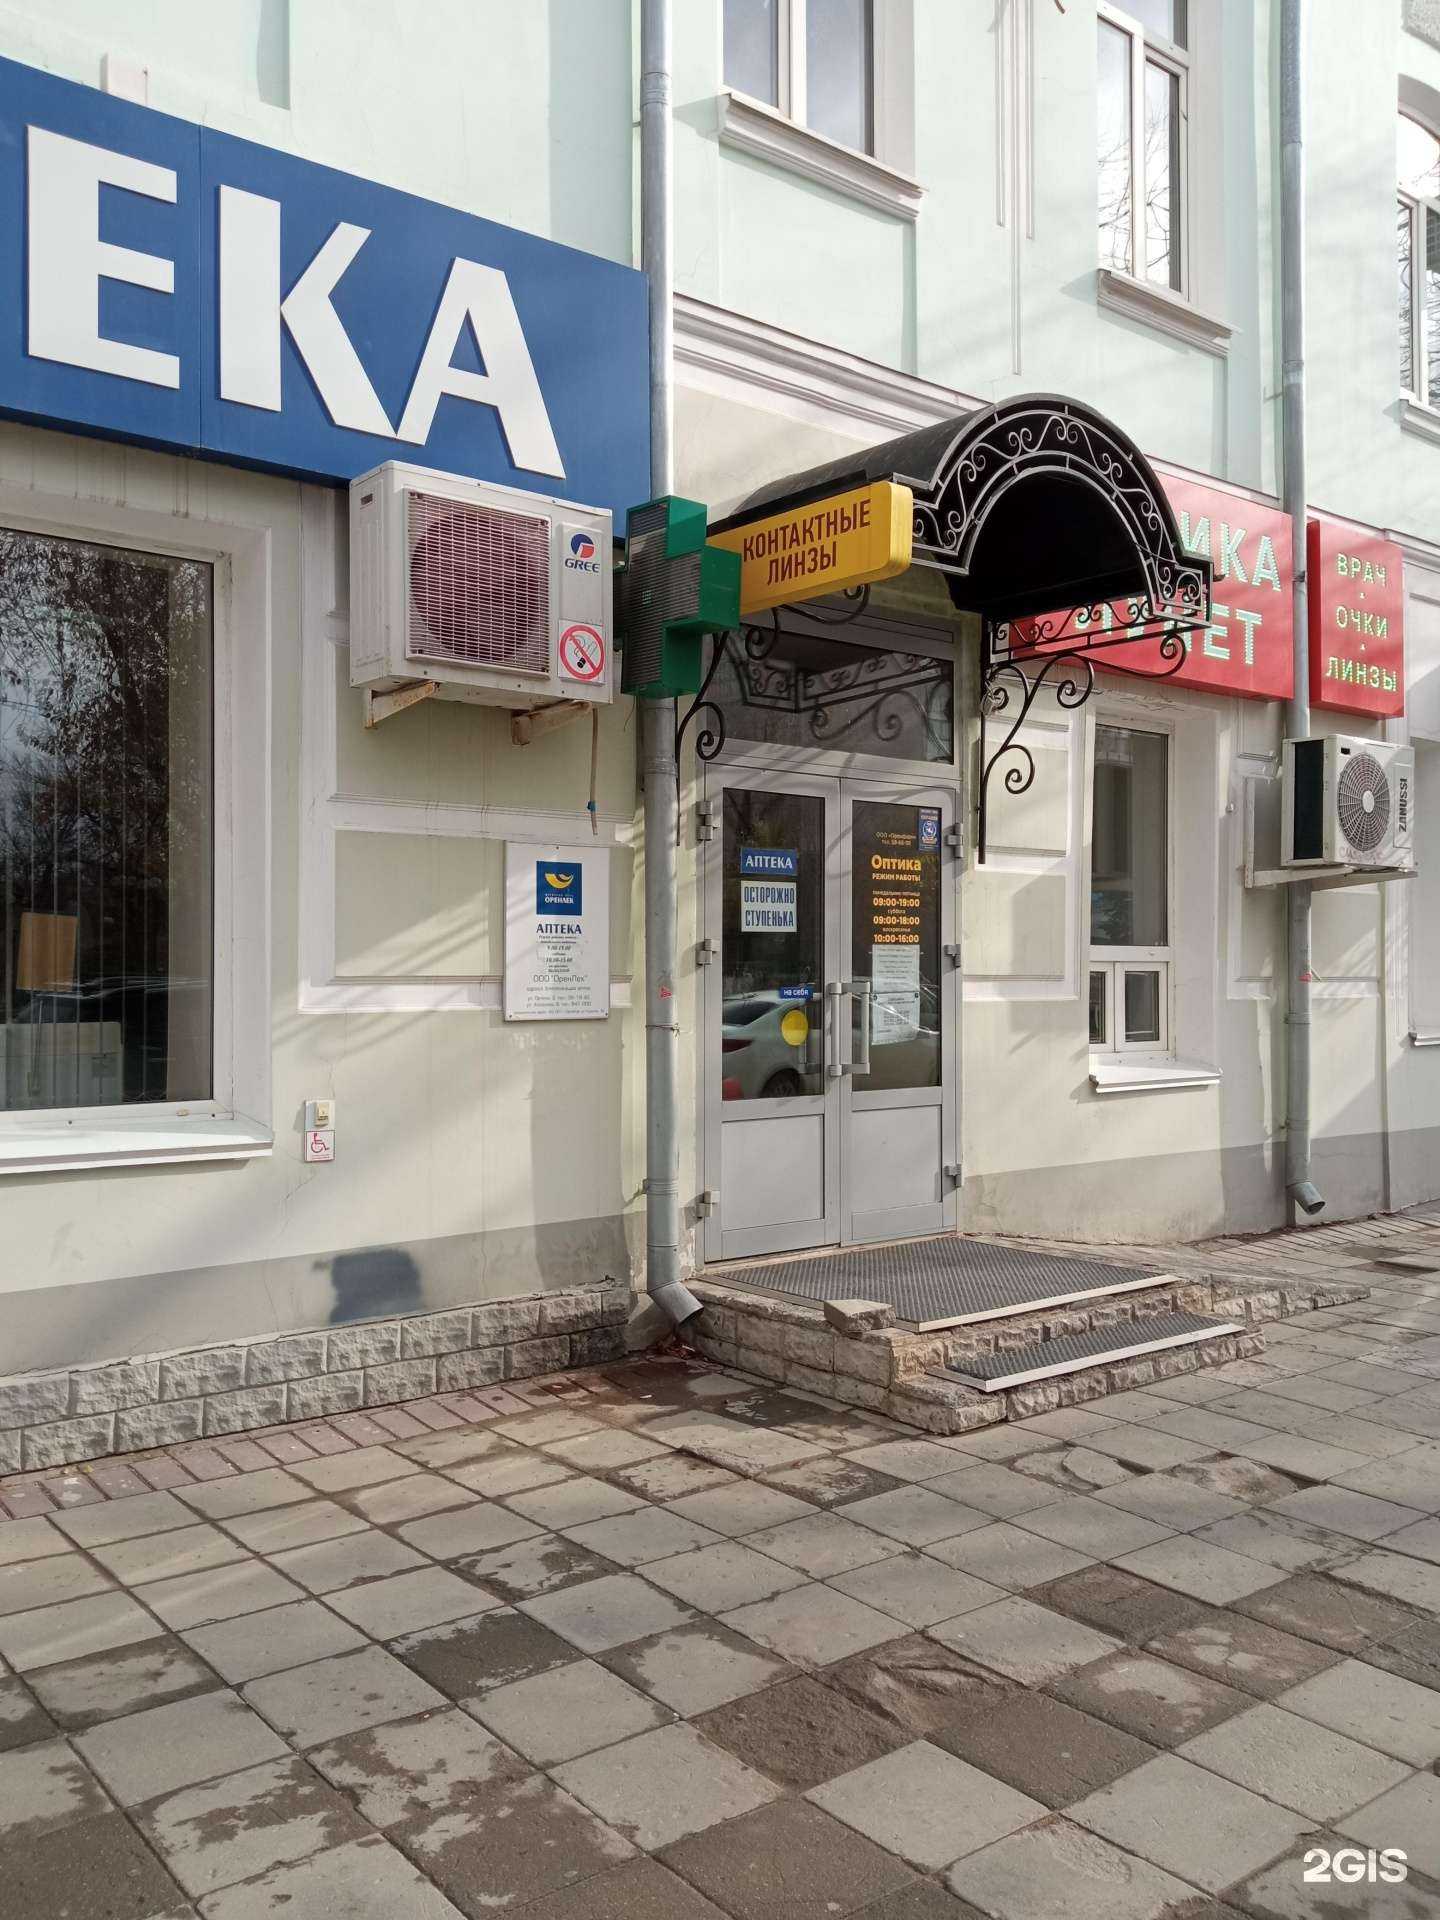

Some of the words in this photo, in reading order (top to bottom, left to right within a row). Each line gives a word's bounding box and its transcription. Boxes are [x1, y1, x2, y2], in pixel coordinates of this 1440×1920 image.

[27, 125, 566, 479] ЕКА
[743, 499, 871, 562] КОНТАКТНЫЕ
[564, 557, 600, 573] GREE
[767, 541, 837, 585] ЛИНЗЫ
[1336, 553, 1386, 586] ВРАЧ
[1336, 605, 1388, 639] ОЧКИ
[1326, 656, 1397, 692] ЛИНЗЫ
[1399, 778, 1408, 832] ZANUSSI
[745, 856, 793, 869] АПТЕКА
[872, 855, 921, 871] Оптика
[896, 874, 921, 882] РАБОТЫ
[744, 886, 795, 904] ОСТОРОЖНО
[873, 897, 920, 907] 09:00-19:00
[745, 910, 794, 927] СТУПЕНЬКА
[873, 916, 920, 925] 09:00-18:00
[536, 923, 582, 935] АПТЕКА
[874, 934, 919, 943] 10:00-16:00
[533, 974, 550, 983] ООО
[793, 988, 809, 996] себя
